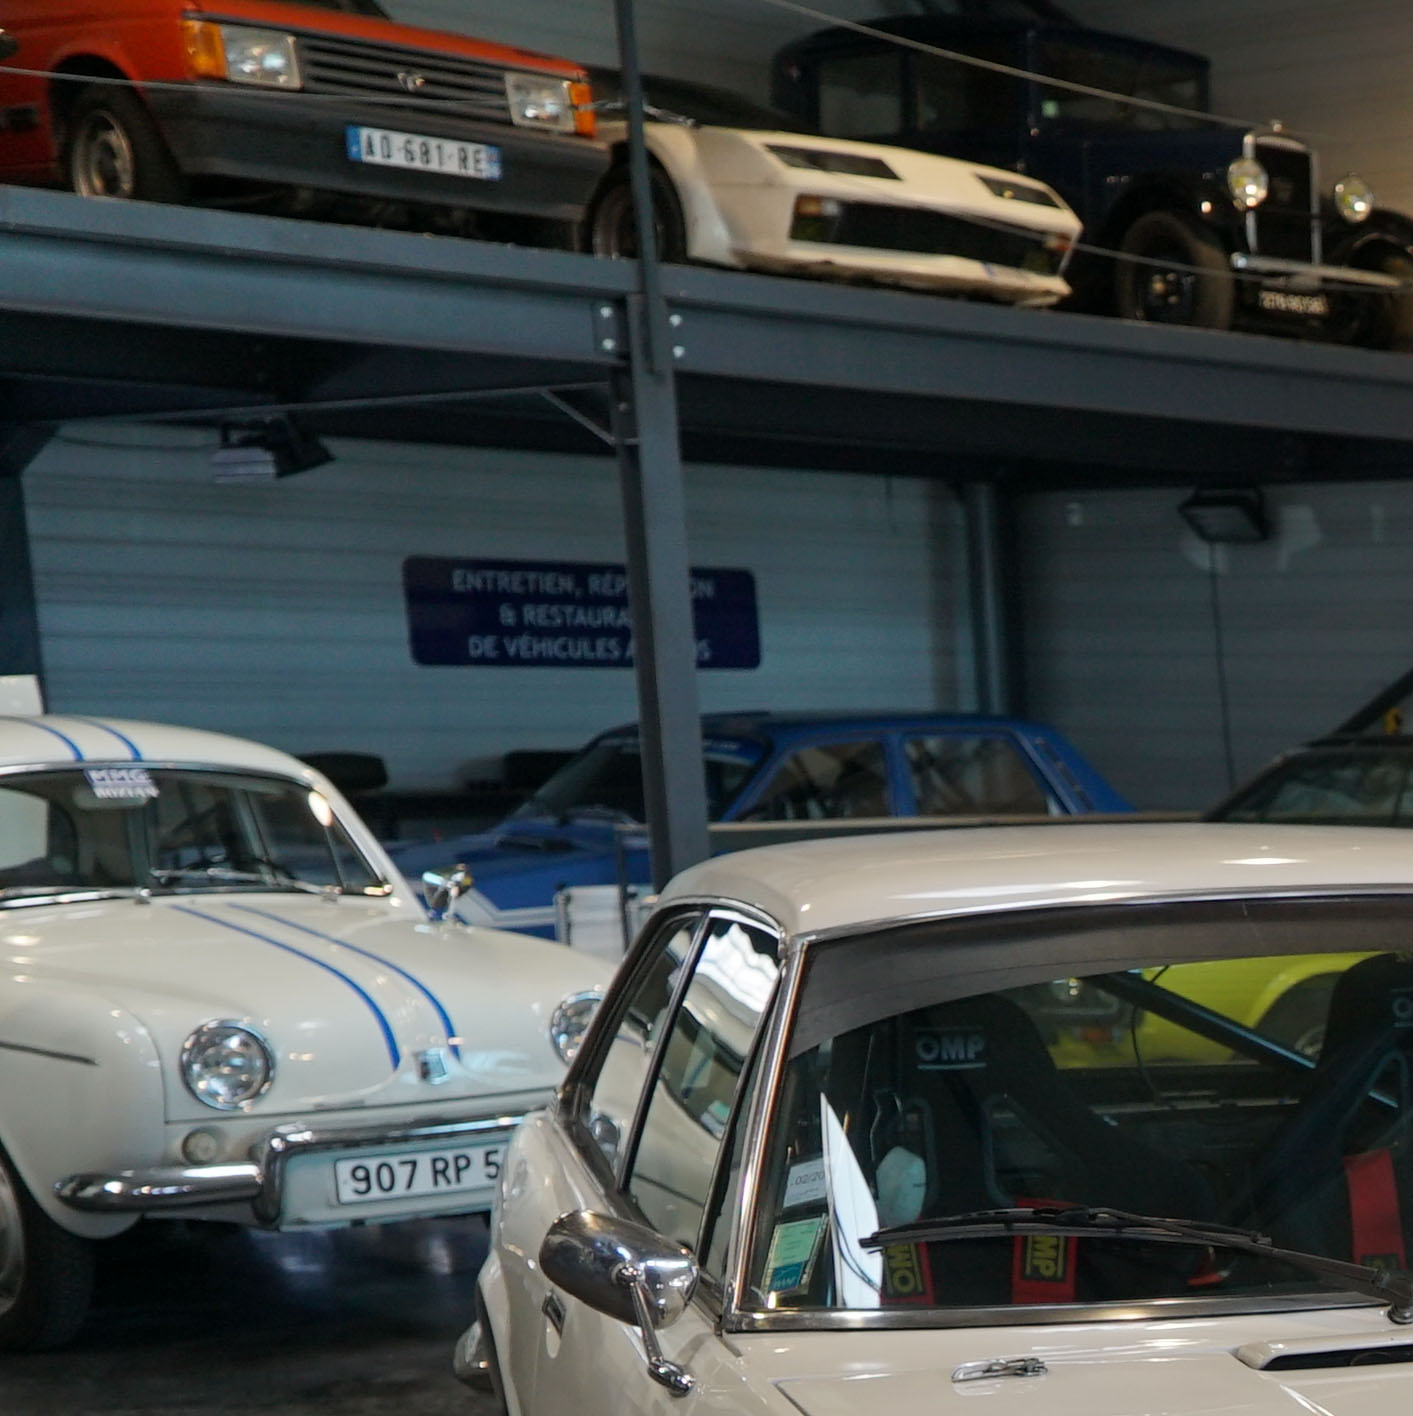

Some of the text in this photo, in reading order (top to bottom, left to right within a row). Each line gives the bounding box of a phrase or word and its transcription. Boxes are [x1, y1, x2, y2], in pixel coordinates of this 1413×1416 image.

[467, 636, 499, 659] DE
[505, 632, 624, 660] VÉHICULES
[916, 1033, 985, 1062] OMP
[351, 1160, 418, 1196] 907
[430, 1154, 471, 1187] RP
